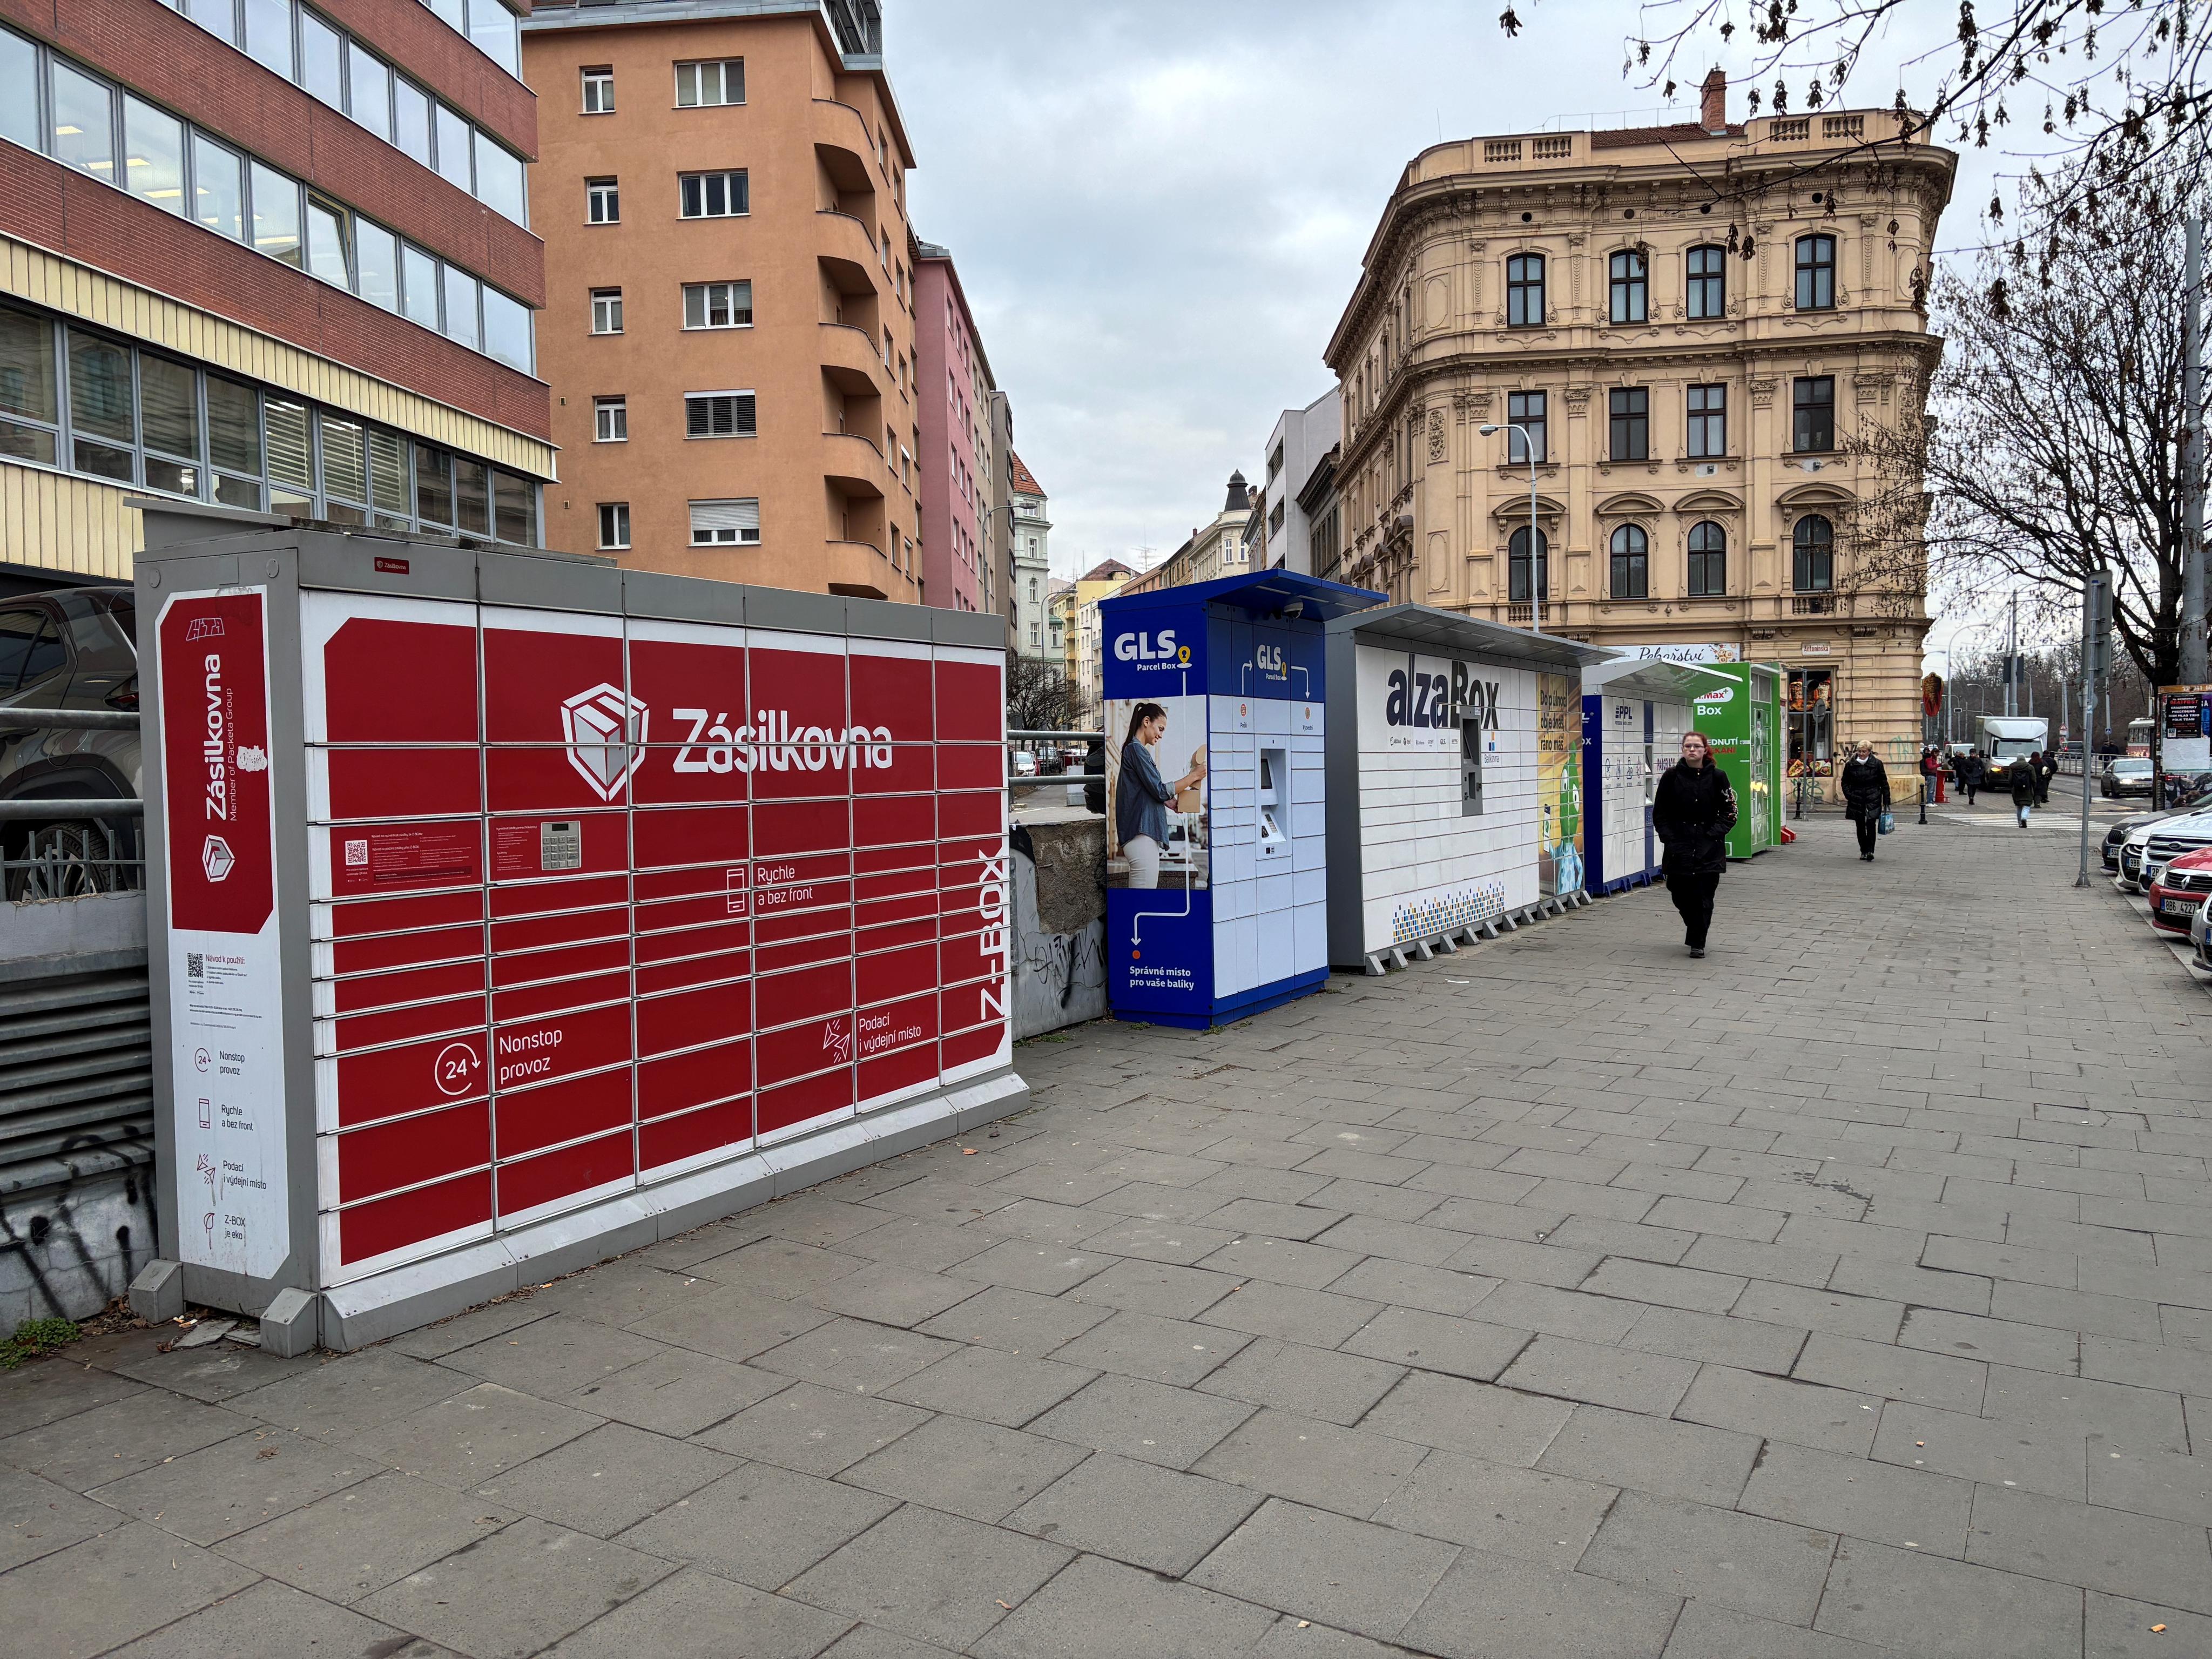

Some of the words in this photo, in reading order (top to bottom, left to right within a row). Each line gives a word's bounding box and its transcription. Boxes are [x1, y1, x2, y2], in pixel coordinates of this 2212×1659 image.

[1114, 630, 1176, 661] GLS
[1257, 644, 1282, 671] GLS
[1137, 663, 1160, 671] Parcel
[1162, 662, 1176, 670] Box
[1386, 653, 1499, 730] alzaBox
[1540, 690, 1548, 705] Do
[225, 688, 234, 720] Group
[1697, 705, 1722, 716] Box
[1619, 705, 1633, 719] PPL
[204, 654, 226, 821] Zásilkovna
[227, 723, 235, 764] Packeta
[672, 708, 893, 773] Zásilkovna
[228, 765, 236, 777] of
[229, 779, 238, 822] Member
[758, 865, 795, 884] Rychle
[758, 894, 765, 906] a
[767, 889, 787, 905] bez
[789, 886, 813, 902] front
[2166, 900, 2176, 911] 8B6
[2180, 903, 2196, 914] 4227
[979, 848, 1004, 1020] Z-BOX
[206, 954, 222, 962] Návod
[1129, 966, 1164, 976] Správné
[1166, 967, 1191, 976] místo
[1130, 979, 1144, 988] pro
[1145, 978, 1165, 987] vaše
[1167, 979, 1194, 991] balíky
[859, 1011, 890, 1033] Podací
[500, 1029, 562, 1055] Nonstop
[859, 1038, 862, 1053] i
[864, 1029, 896, 1053] výdejní
[898, 1026, 921, 1042] místo
[198, 1056, 206, 1064] 24
[219, 1050, 245, 1064] Nonstop
[220, 1066, 240, 1075] provoz
[446, 1058, 467, 1080] 24
[501, 1057, 551, 1084] provoz
[221, 1104, 242, 1116] Rychle
[226, 1119, 238, 1129] bez
[239, 1121, 253, 1131] front
[223, 1160, 244, 1172] Podací
[223, 1174, 226, 1183] i
[226, 1175, 248, 1189] výdejní
[249, 1179, 267, 1189] místo
[224, 1215, 246, 1227] Z-BOX
[225, 1228, 231, 1239] je
[232, 1230, 242, 1240] eko
